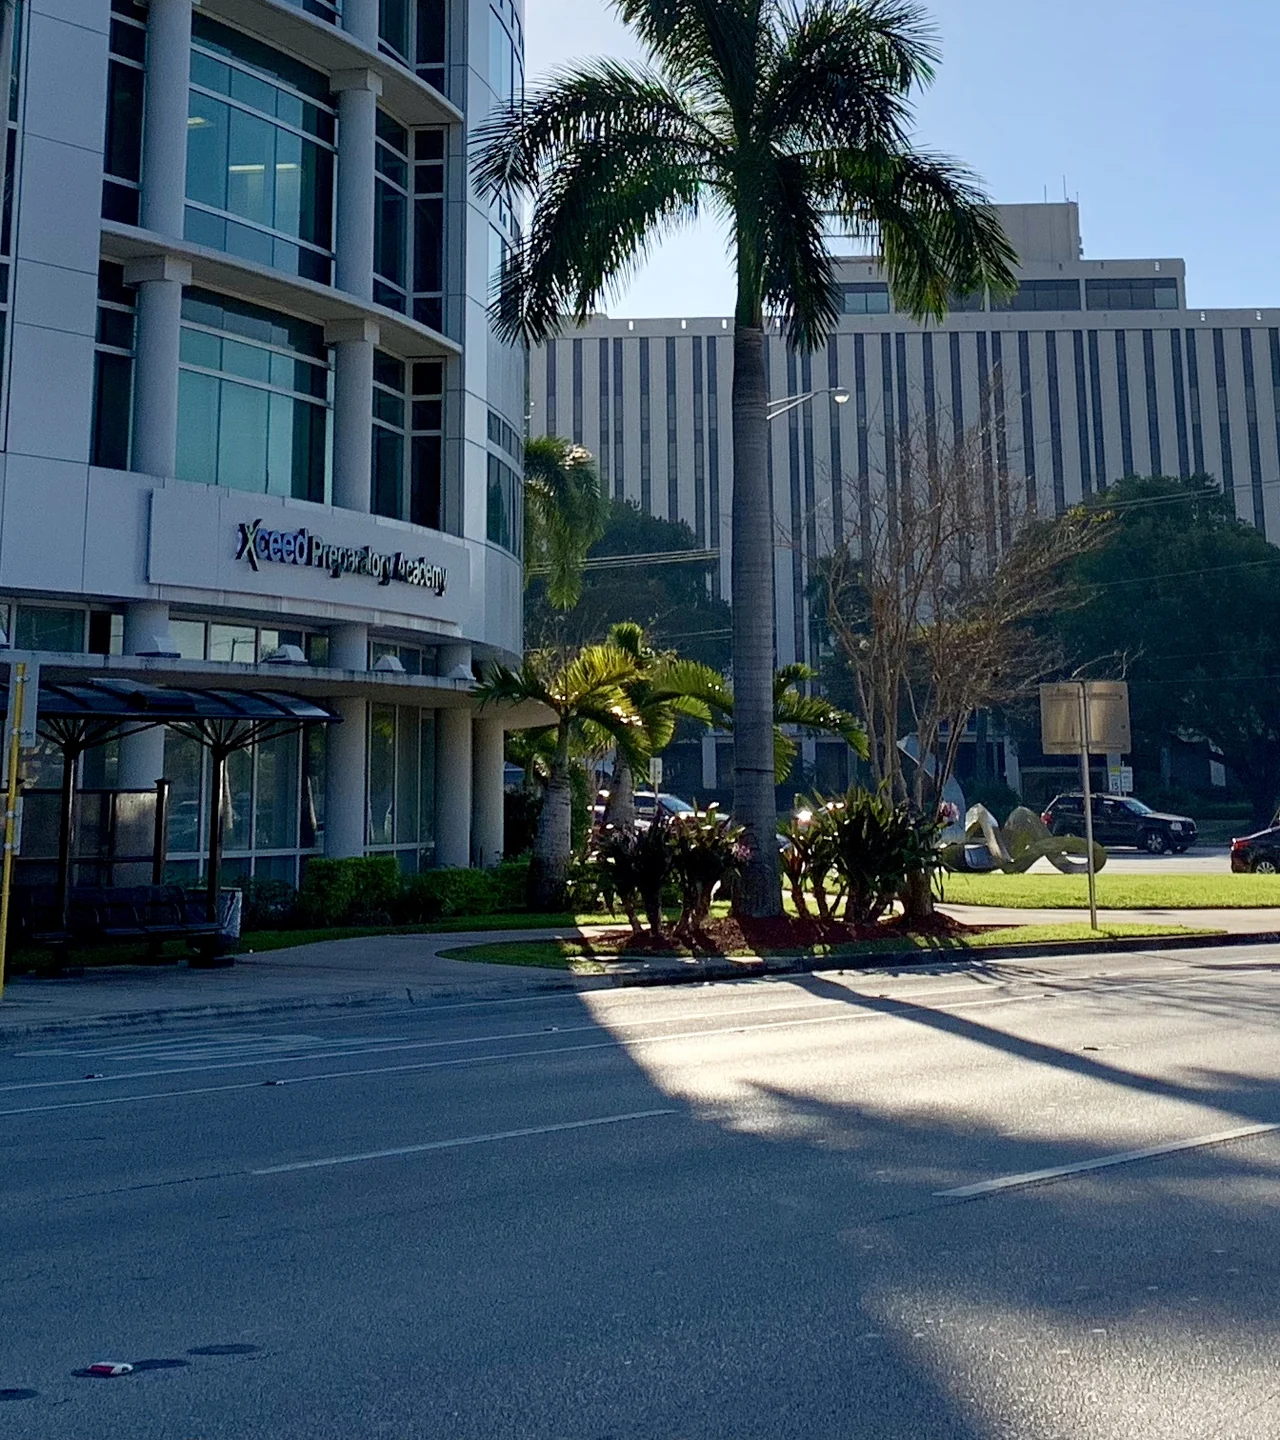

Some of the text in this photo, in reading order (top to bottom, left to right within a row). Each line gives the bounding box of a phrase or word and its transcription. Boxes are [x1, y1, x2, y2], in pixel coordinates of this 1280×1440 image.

[236, 518, 449, 597] Xceed Preparatory Academy
[1111, 782, 1119, 790] 15
